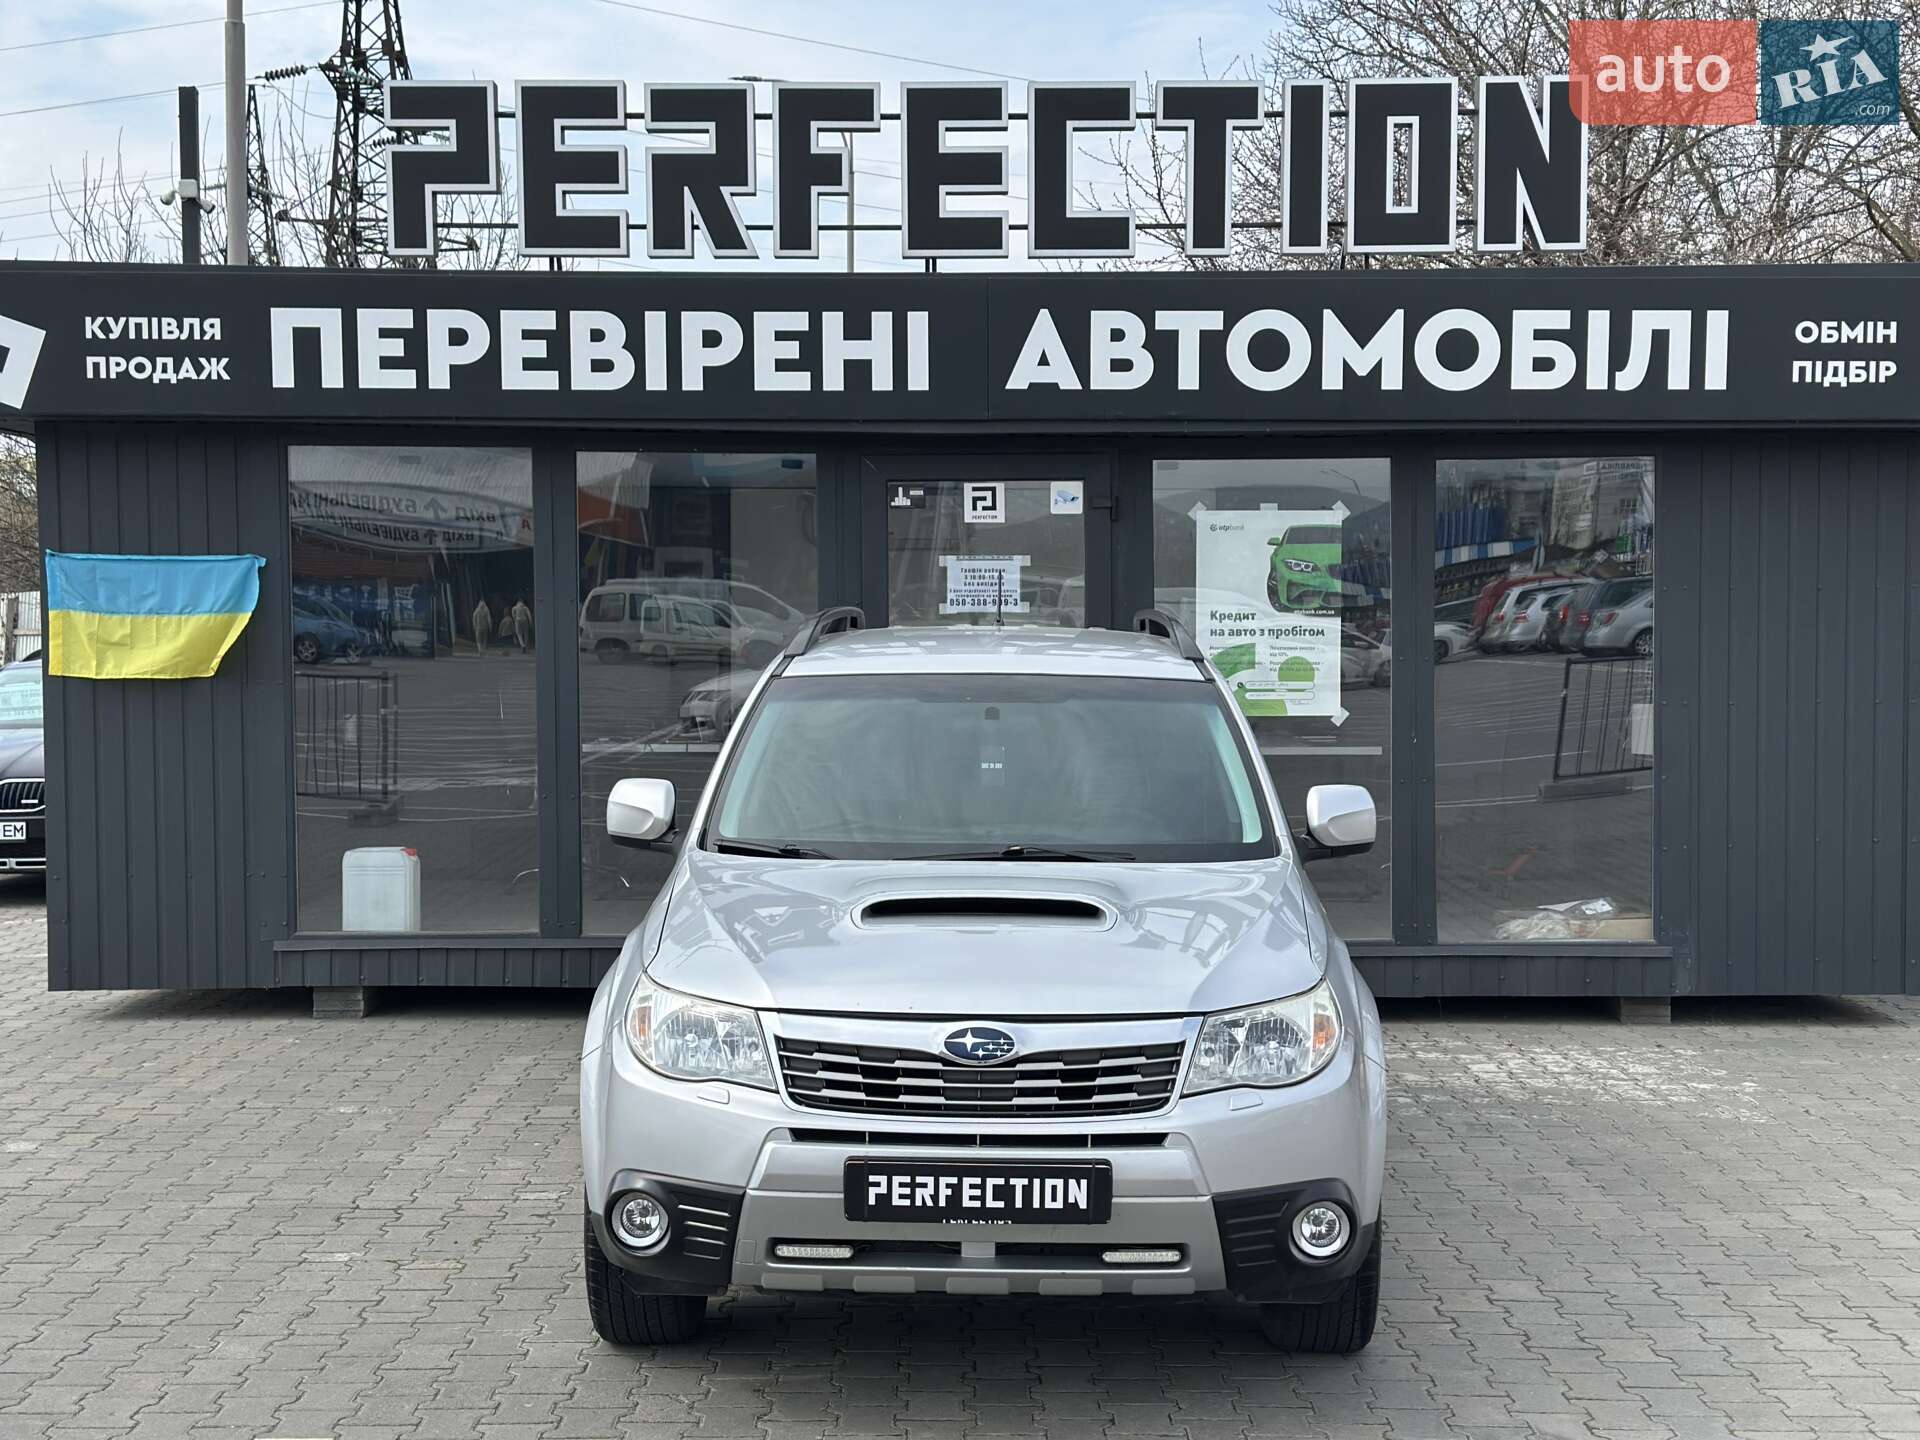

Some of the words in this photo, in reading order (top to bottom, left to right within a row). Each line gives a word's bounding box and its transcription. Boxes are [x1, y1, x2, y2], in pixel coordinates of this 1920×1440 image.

[384, 75, 1589, 259] PERFECTION
[84, 316, 222, 341] КУПІВЛЯ
[1794, 320, 1898, 344] ОБМІН
[270, 307, 930, 392] ПЕРЕВІРЕНІ
[1004, 308, 1730, 392] АВТОМОБІЛІ
[85, 355, 231, 385] ПРОДАЖ
[1791, 360, 1897, 388] ПІДБІР
[1209, 610, 1257, 625] Кредит
[1209, 627, 1225, 637] на
[1227, 627, 1257, 637] авто
[1259, 627, 1265, 637] з
[1267, 625, 1326, 640] пробігом
[3, 824, 24, 837] EM
[868, 1174, 1088, 1210] PERFECTION
